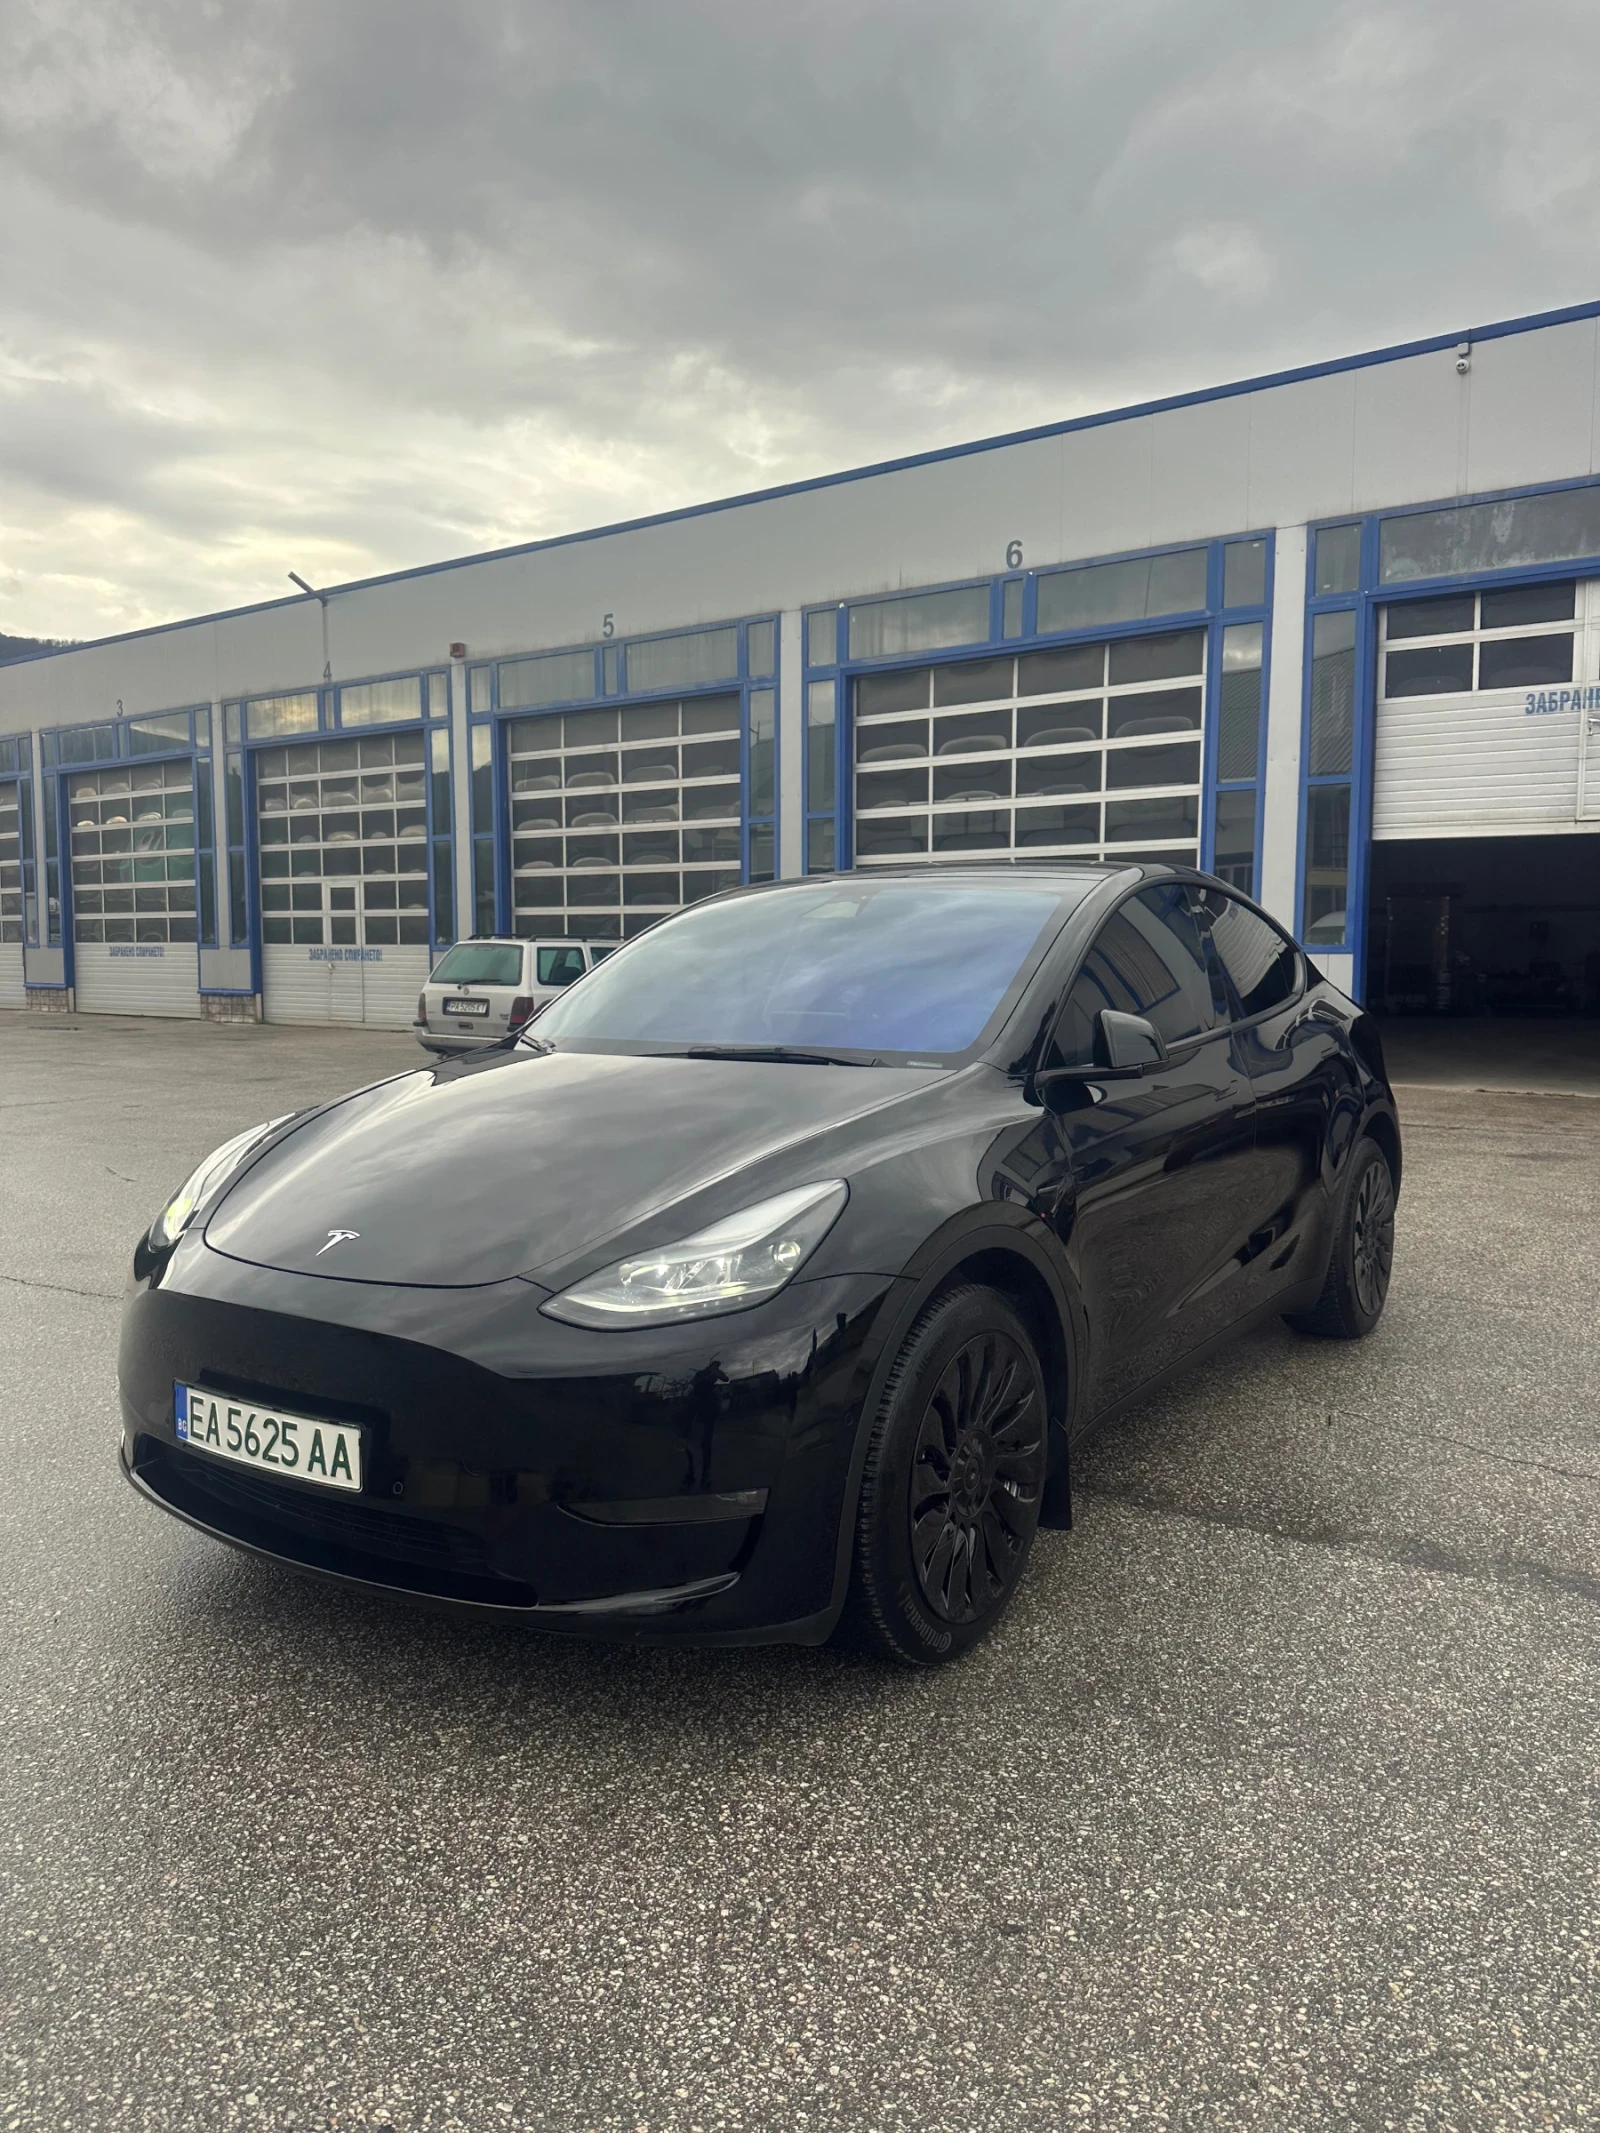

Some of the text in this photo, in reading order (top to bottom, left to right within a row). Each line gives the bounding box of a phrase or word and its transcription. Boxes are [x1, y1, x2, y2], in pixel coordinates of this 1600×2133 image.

[1006, 539, 1023, 569] 6
[603, 613, 614, 638] 5
[323, 660, 332, 681] 4
[116, 698, 123, 716] 3
[177, 1418, 188, 1433] BG
[227, 1406, 300, 1467] 5625
[897, 1593, 952, 1653] Continental
